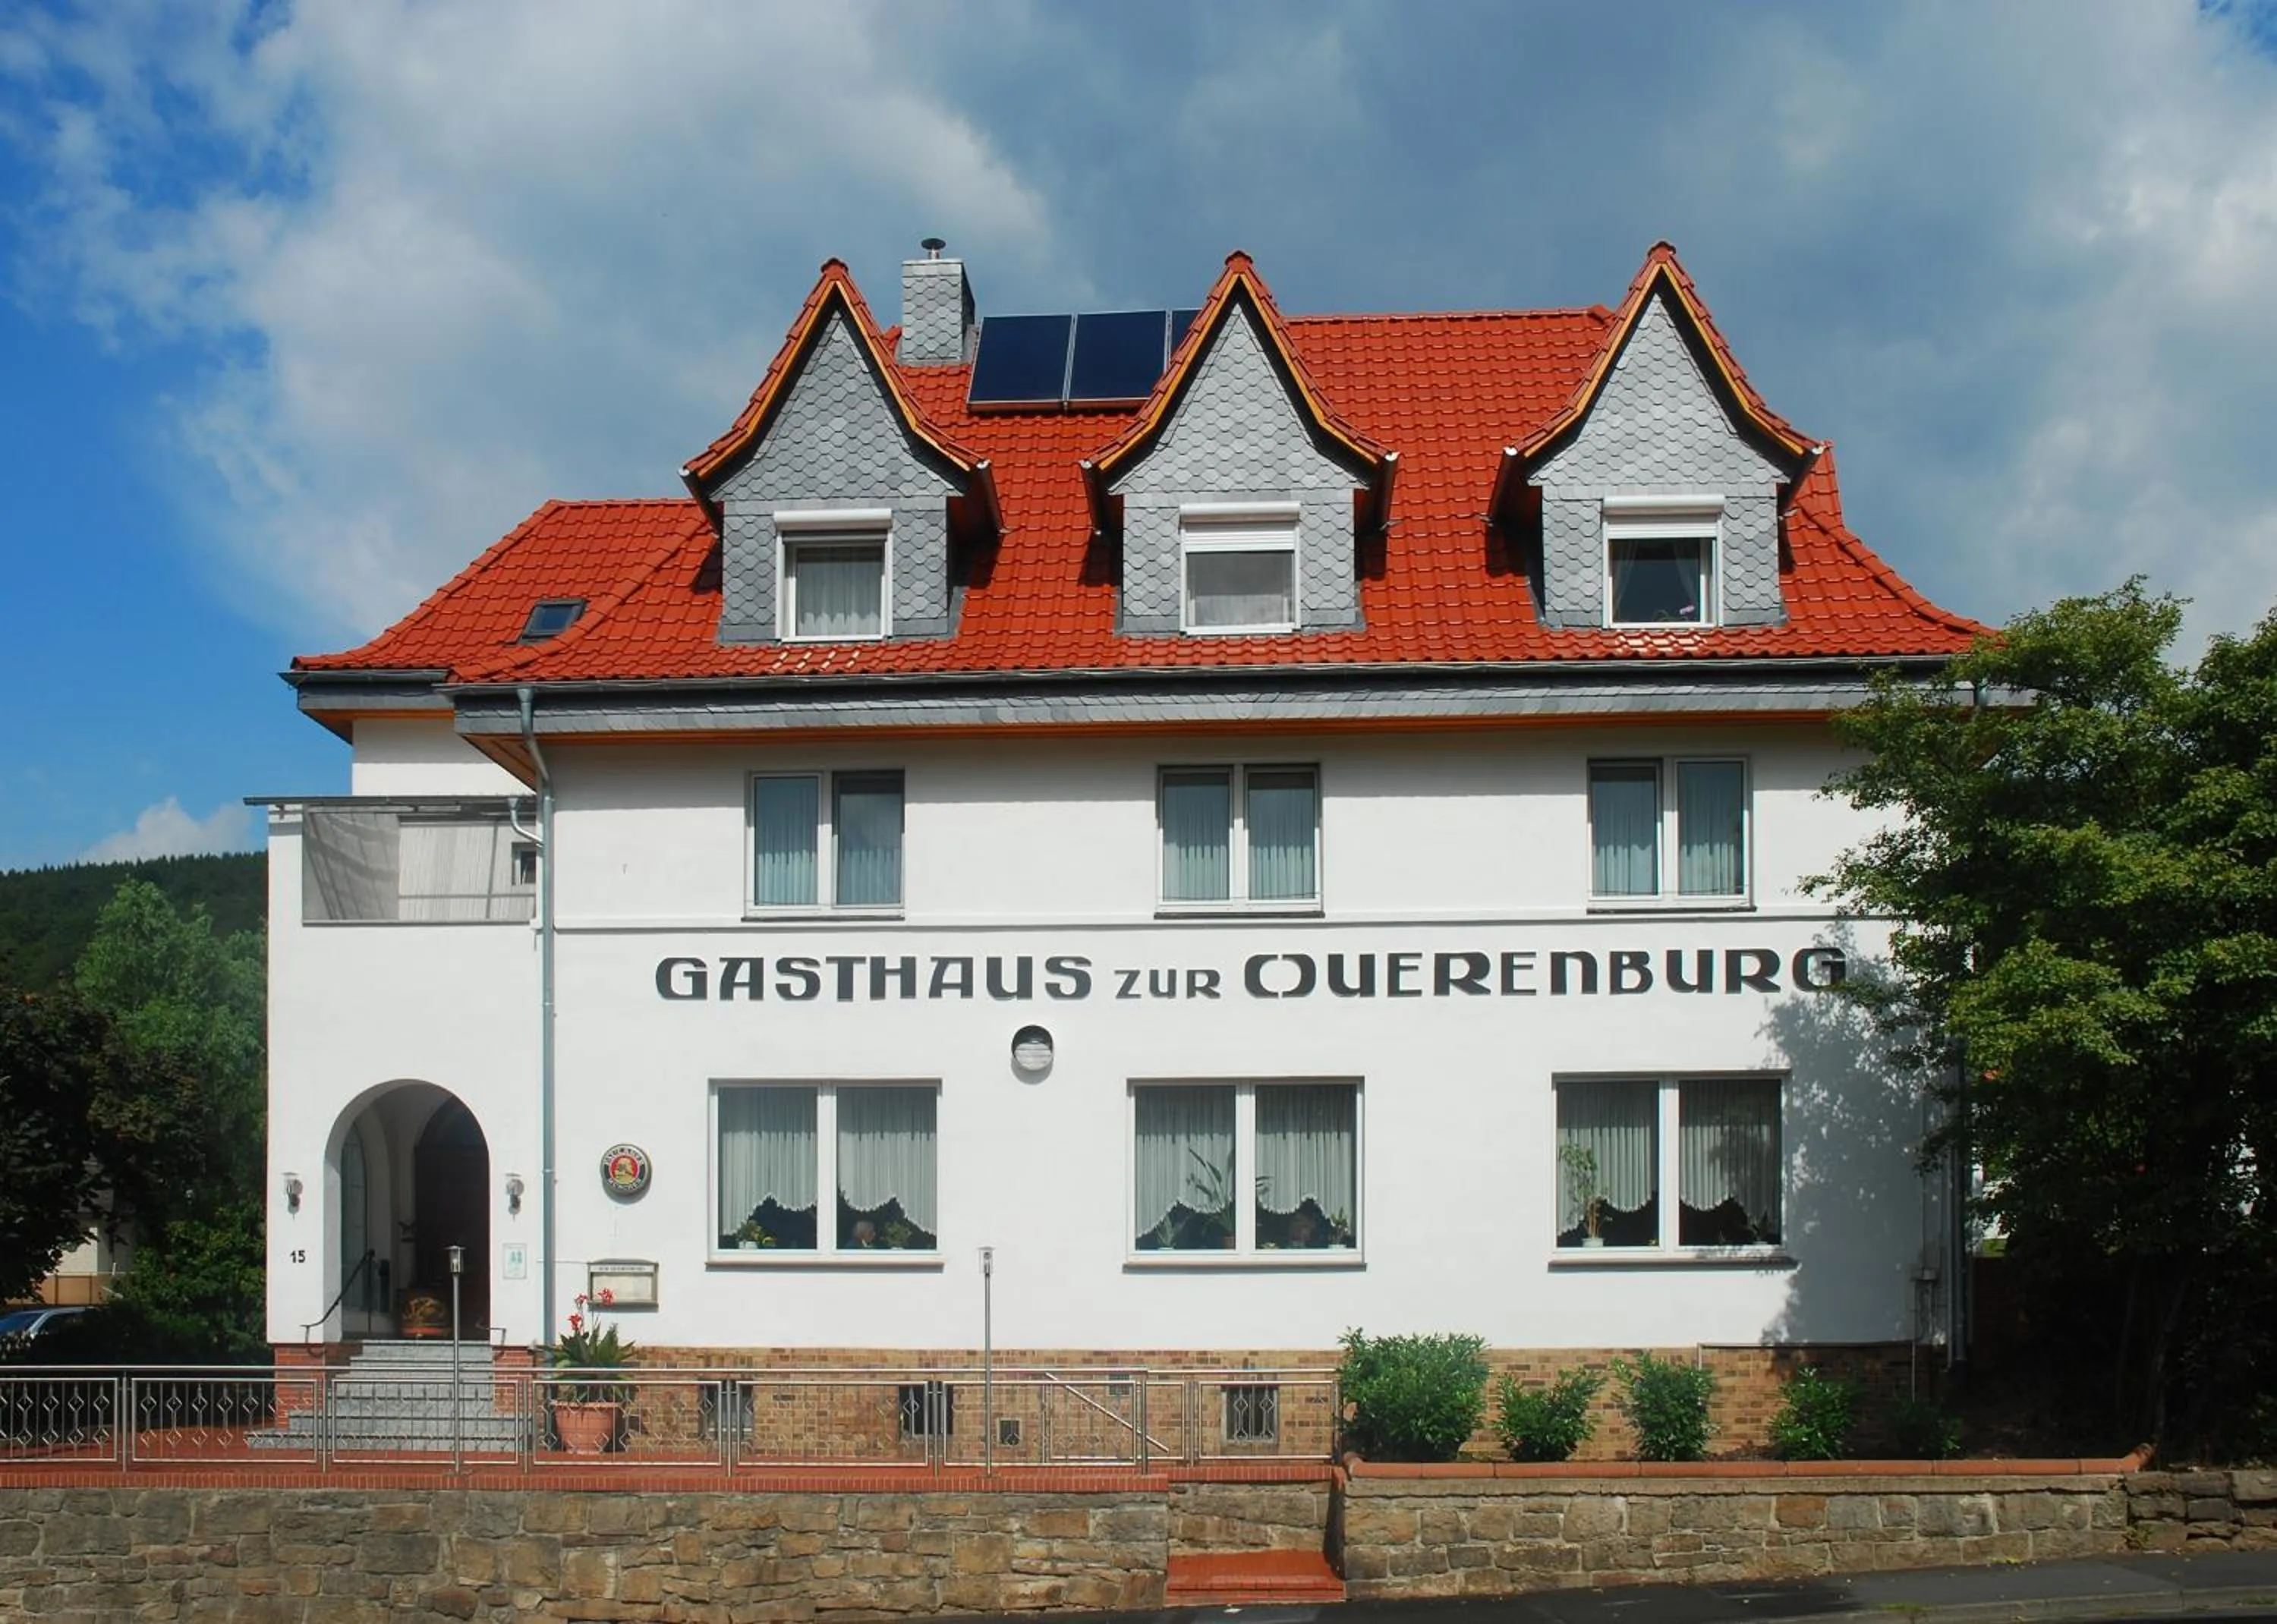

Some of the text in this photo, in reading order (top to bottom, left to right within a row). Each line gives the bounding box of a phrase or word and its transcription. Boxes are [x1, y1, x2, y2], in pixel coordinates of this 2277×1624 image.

[655, 956, 1091, 1001] GASTHAUS
[1115, 969, 1220, 999] ZUR
[290, 1250, 306, 1263] 15
